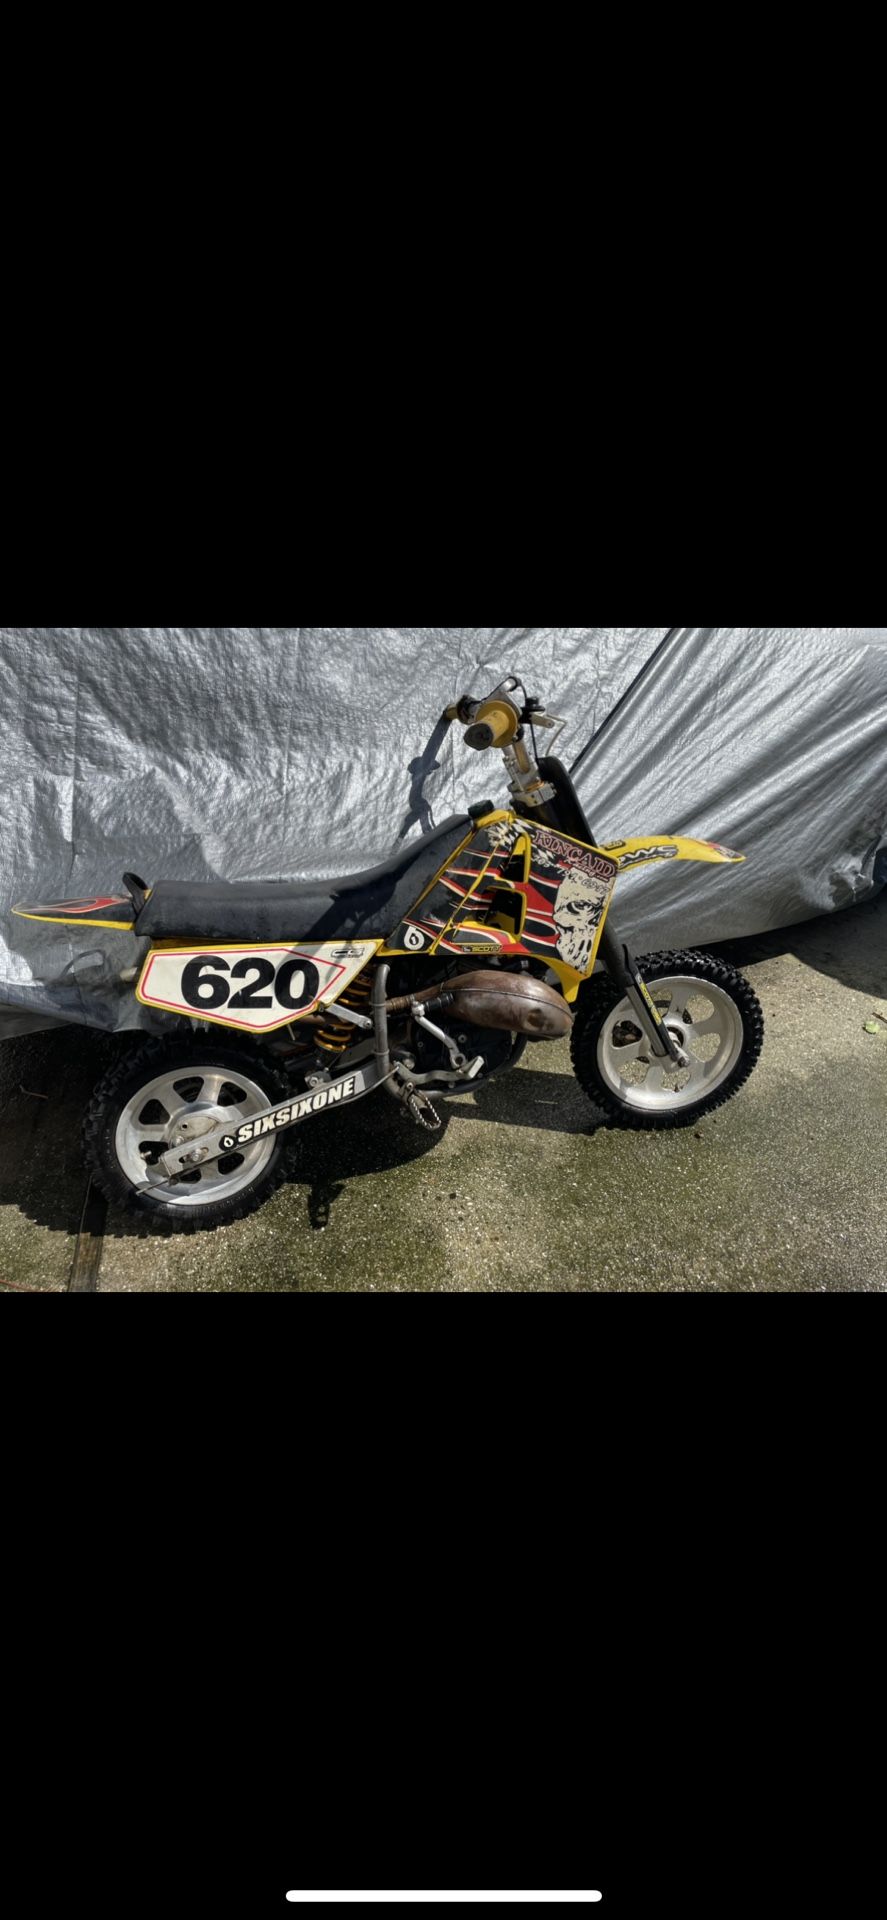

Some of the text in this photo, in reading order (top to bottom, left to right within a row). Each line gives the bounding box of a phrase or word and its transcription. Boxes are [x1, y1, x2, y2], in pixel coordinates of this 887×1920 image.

[533, 830, 616, 877] KINCAID
[181, 955, 319, 1010] 620
[237, 1078, 355, 1143] SIXSIXONE
